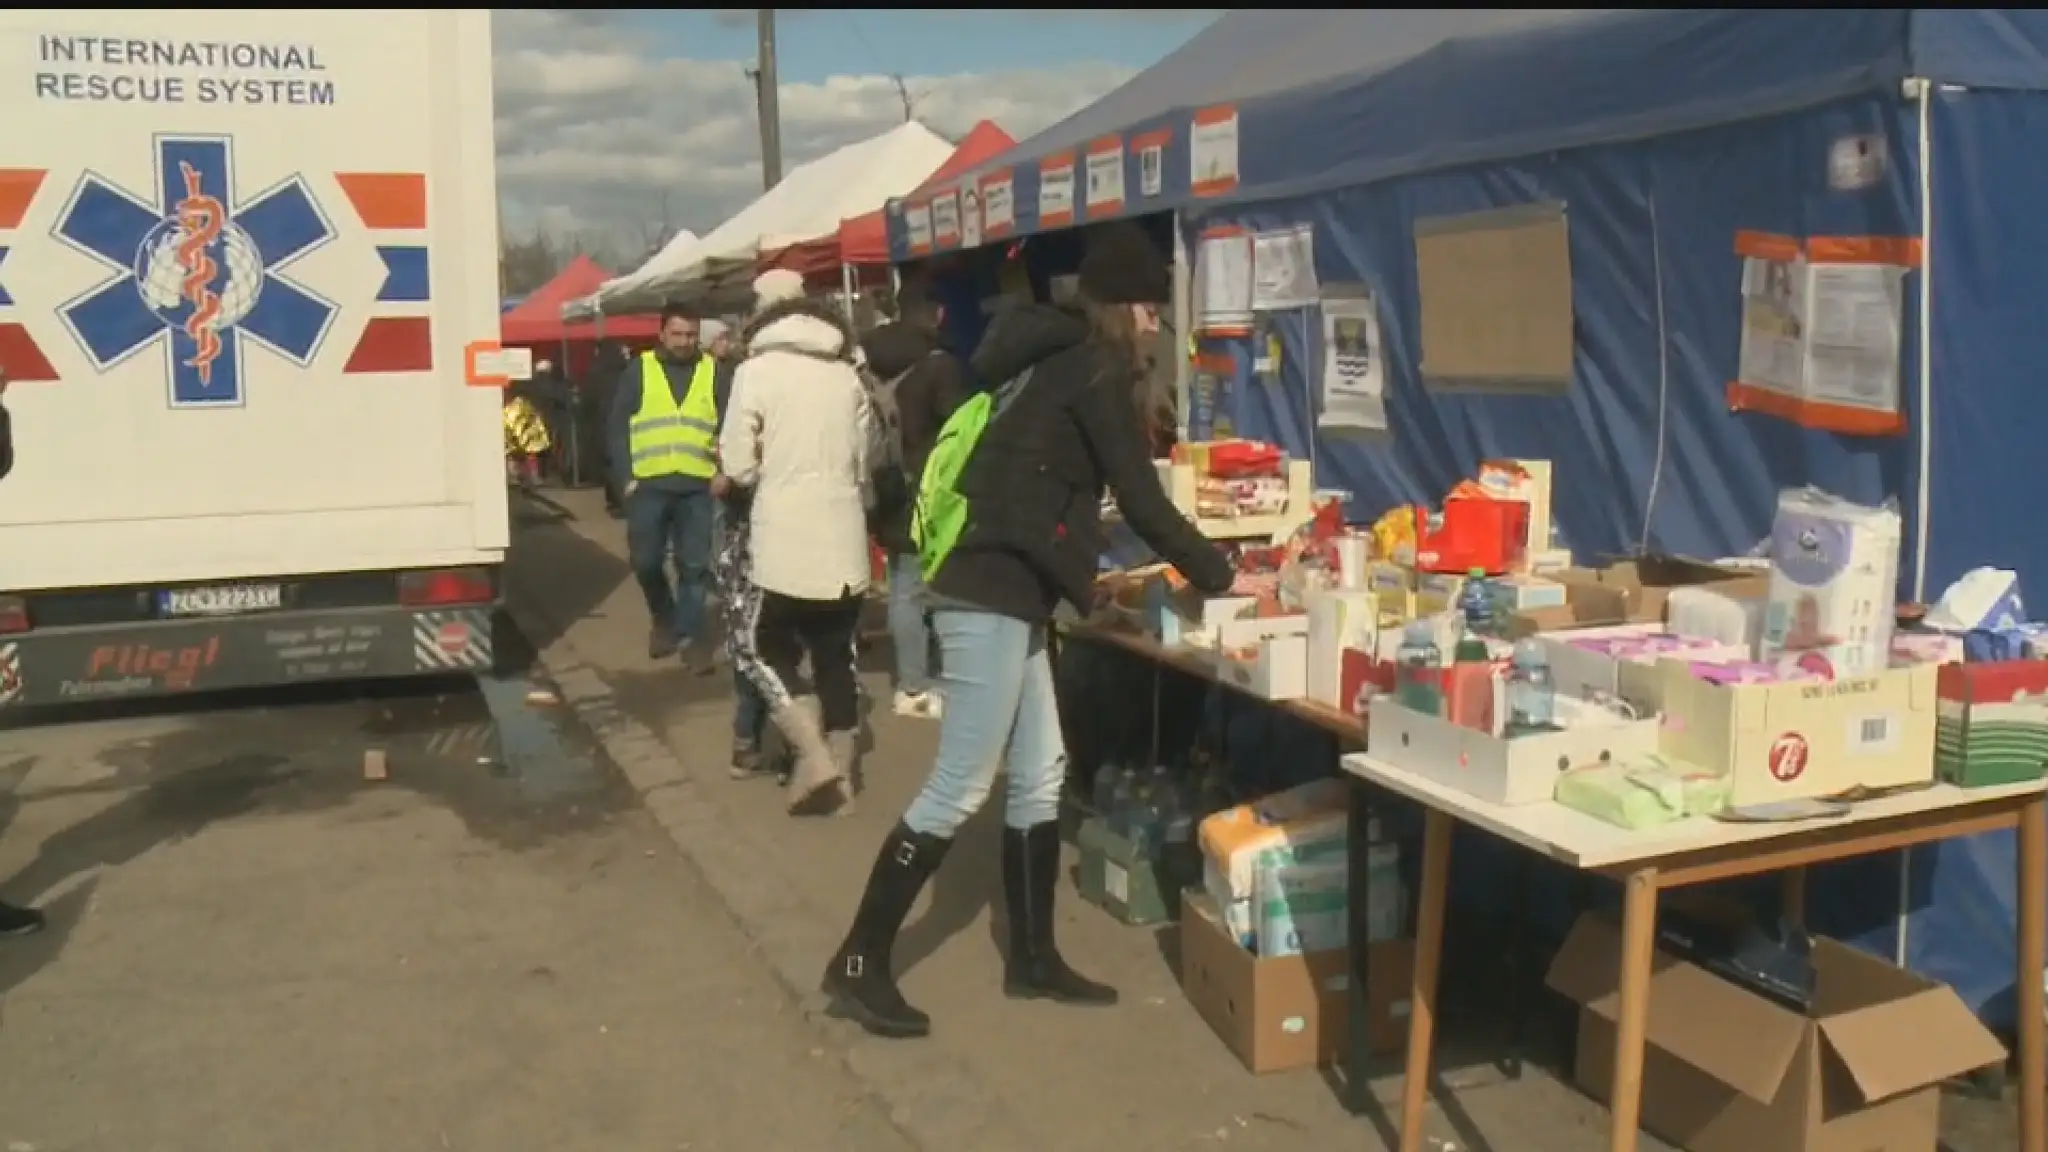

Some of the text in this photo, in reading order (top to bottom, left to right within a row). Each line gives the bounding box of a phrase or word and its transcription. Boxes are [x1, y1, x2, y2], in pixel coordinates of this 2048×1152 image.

[40, 34, 326, 70] INTERNATIONAL
[36, 72, 335, 105] RESCUE SYSTEM
